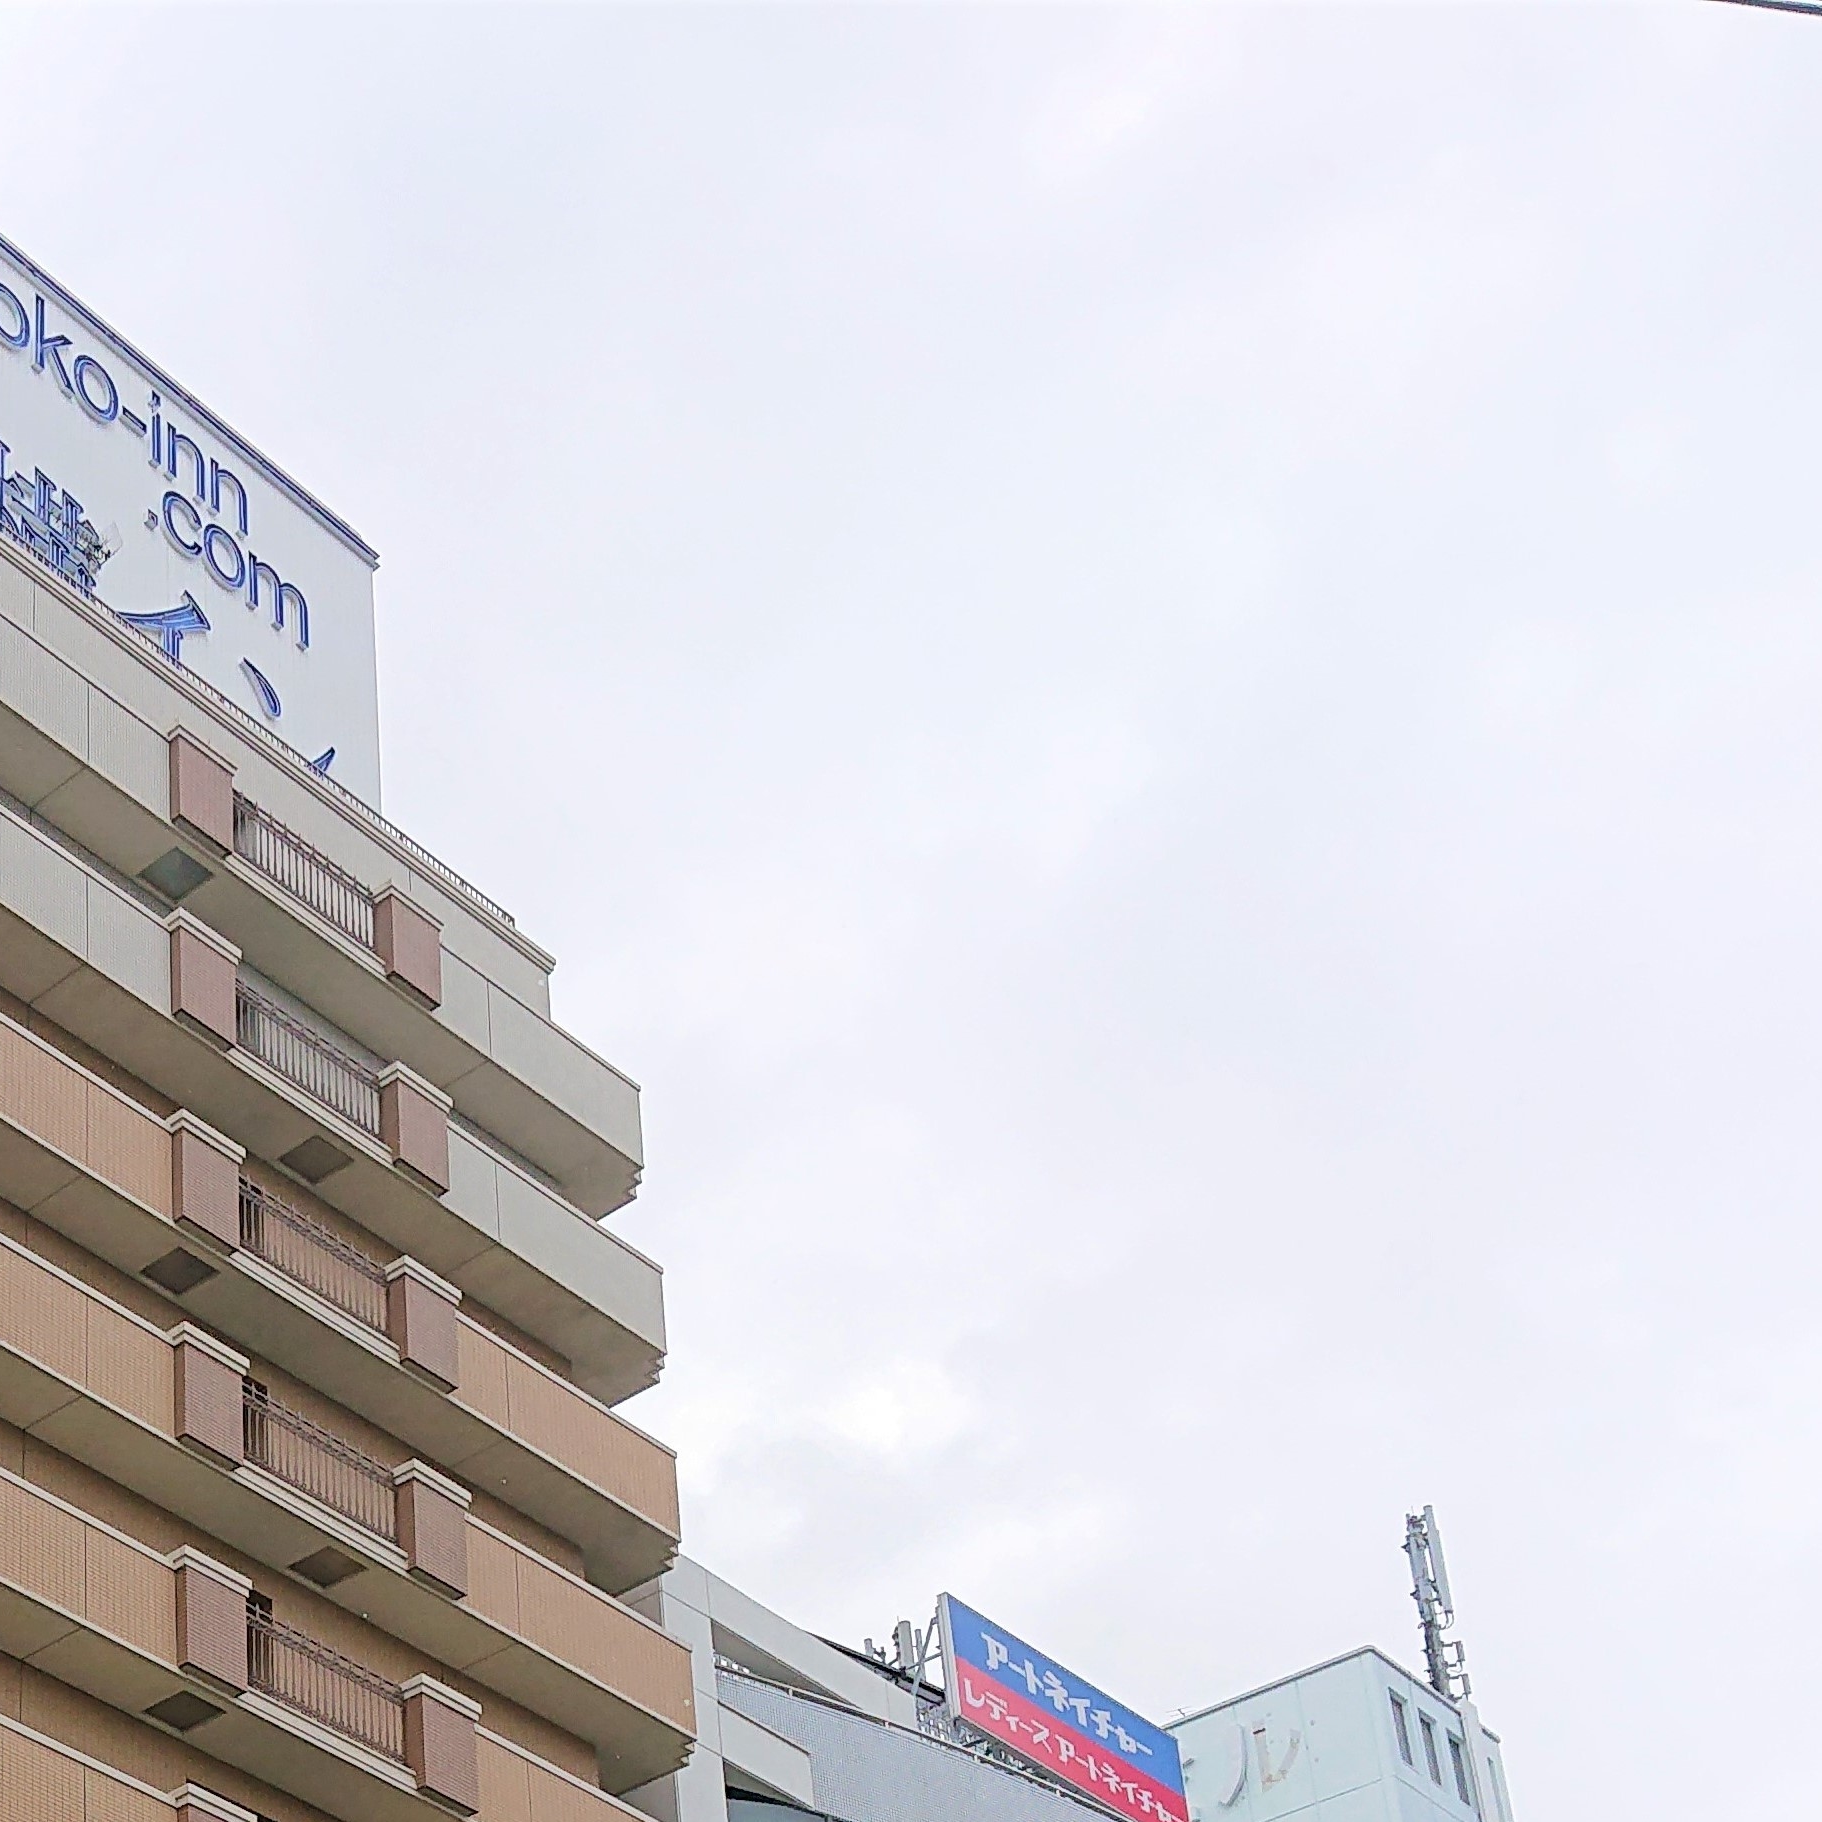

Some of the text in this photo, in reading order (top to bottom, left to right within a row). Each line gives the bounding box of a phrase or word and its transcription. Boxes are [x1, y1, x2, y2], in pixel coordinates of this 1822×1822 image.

[143, 489, 312, 650] .com
[980, 1632, 1153, 1756] アートネイチャー
